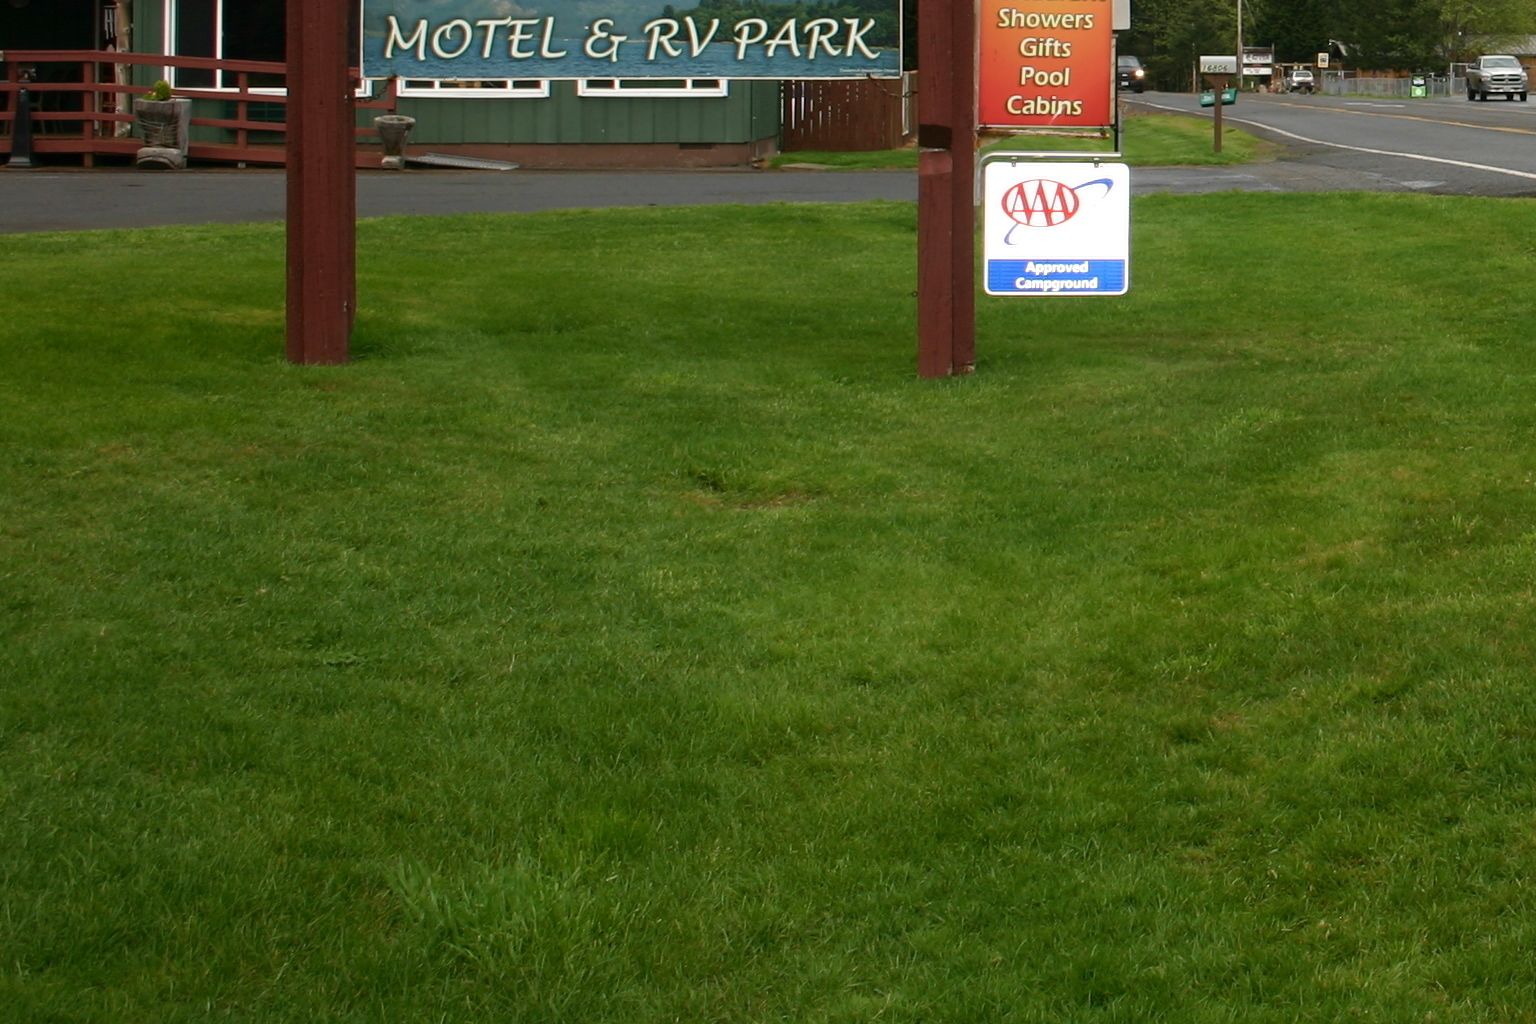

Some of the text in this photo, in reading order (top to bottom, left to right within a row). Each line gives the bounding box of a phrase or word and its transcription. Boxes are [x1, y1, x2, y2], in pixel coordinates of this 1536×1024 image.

[998, 8, 1095, 30] Showers
[384, 16, 882, 63] MOTEL & RV PARK
[1019, 37, 1072, 58] Gifts
[1019, 66, 1071, 88] Pool
[1006, 95, 1084, 116] Cabins
[1004, 179, 1076, 227] AAA
[1025, 261, 1089, 276] Approved
[1014, 277, 1099, 292] Campground
